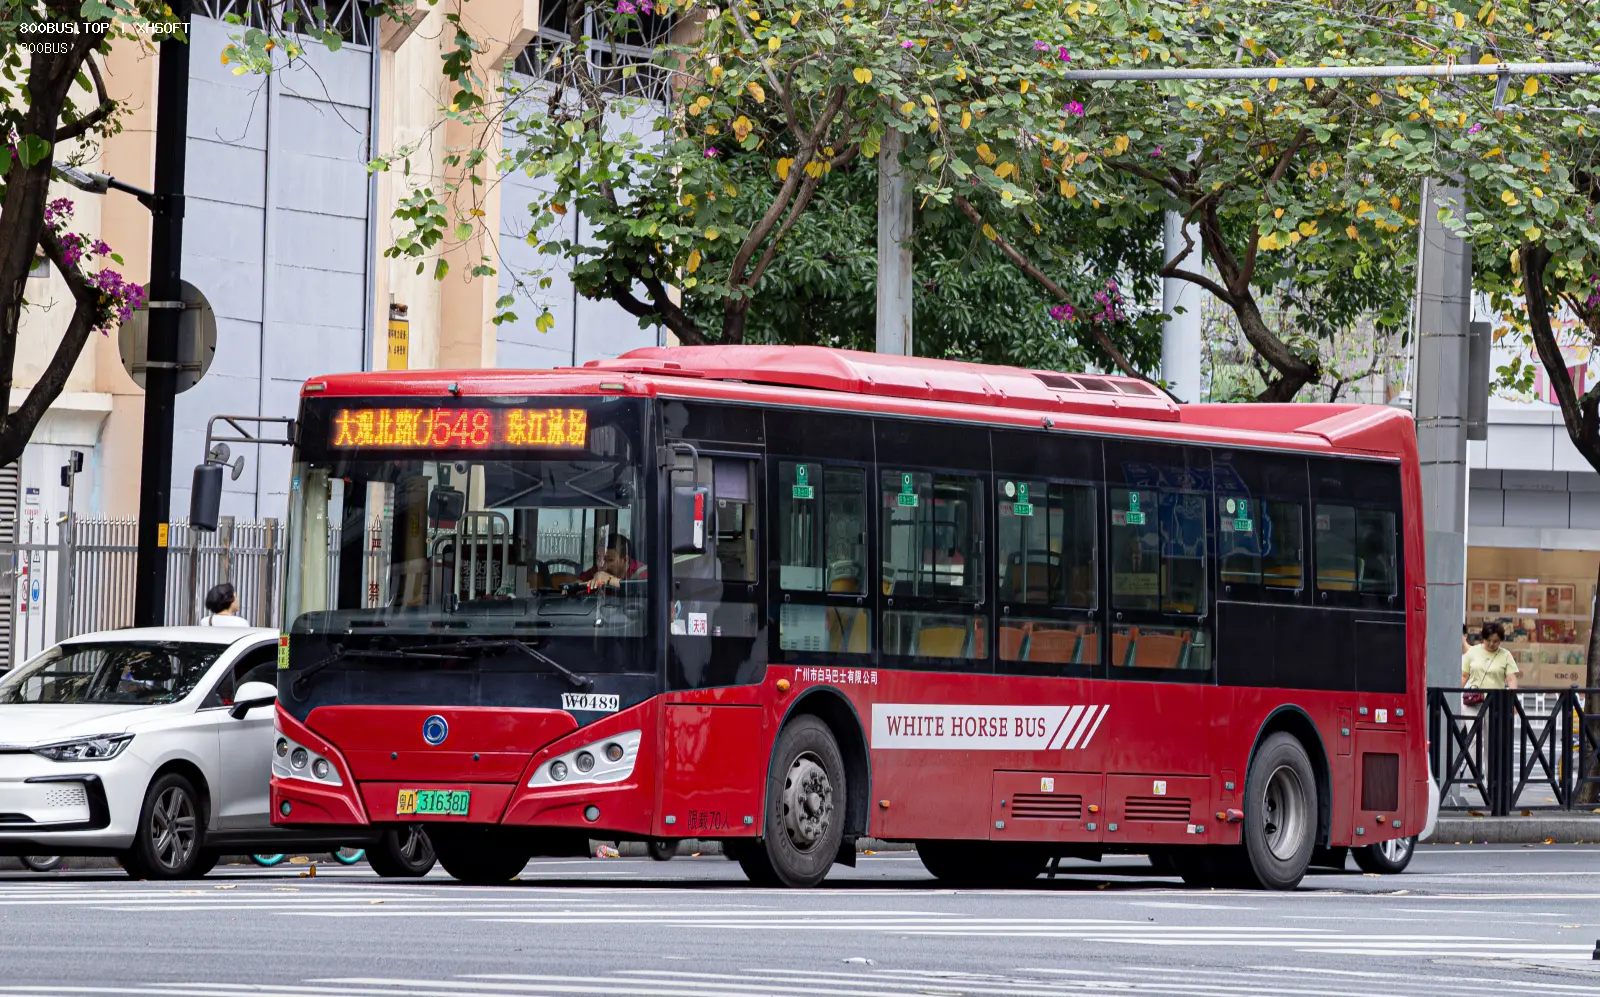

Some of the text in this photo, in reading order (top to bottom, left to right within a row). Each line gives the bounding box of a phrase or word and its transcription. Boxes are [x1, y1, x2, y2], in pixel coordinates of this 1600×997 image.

[432, 411, 489, 445] 548
[506, 408, 587, 446] 珠江泳场
[794, 666, 878, 686] 广州市白马巴士有限公司
[564, 694, 618, 710] W0489
[886, 715, 1046, 738] WHITE HORSE BUS
[687, 809, 730, 831] 限载70人
